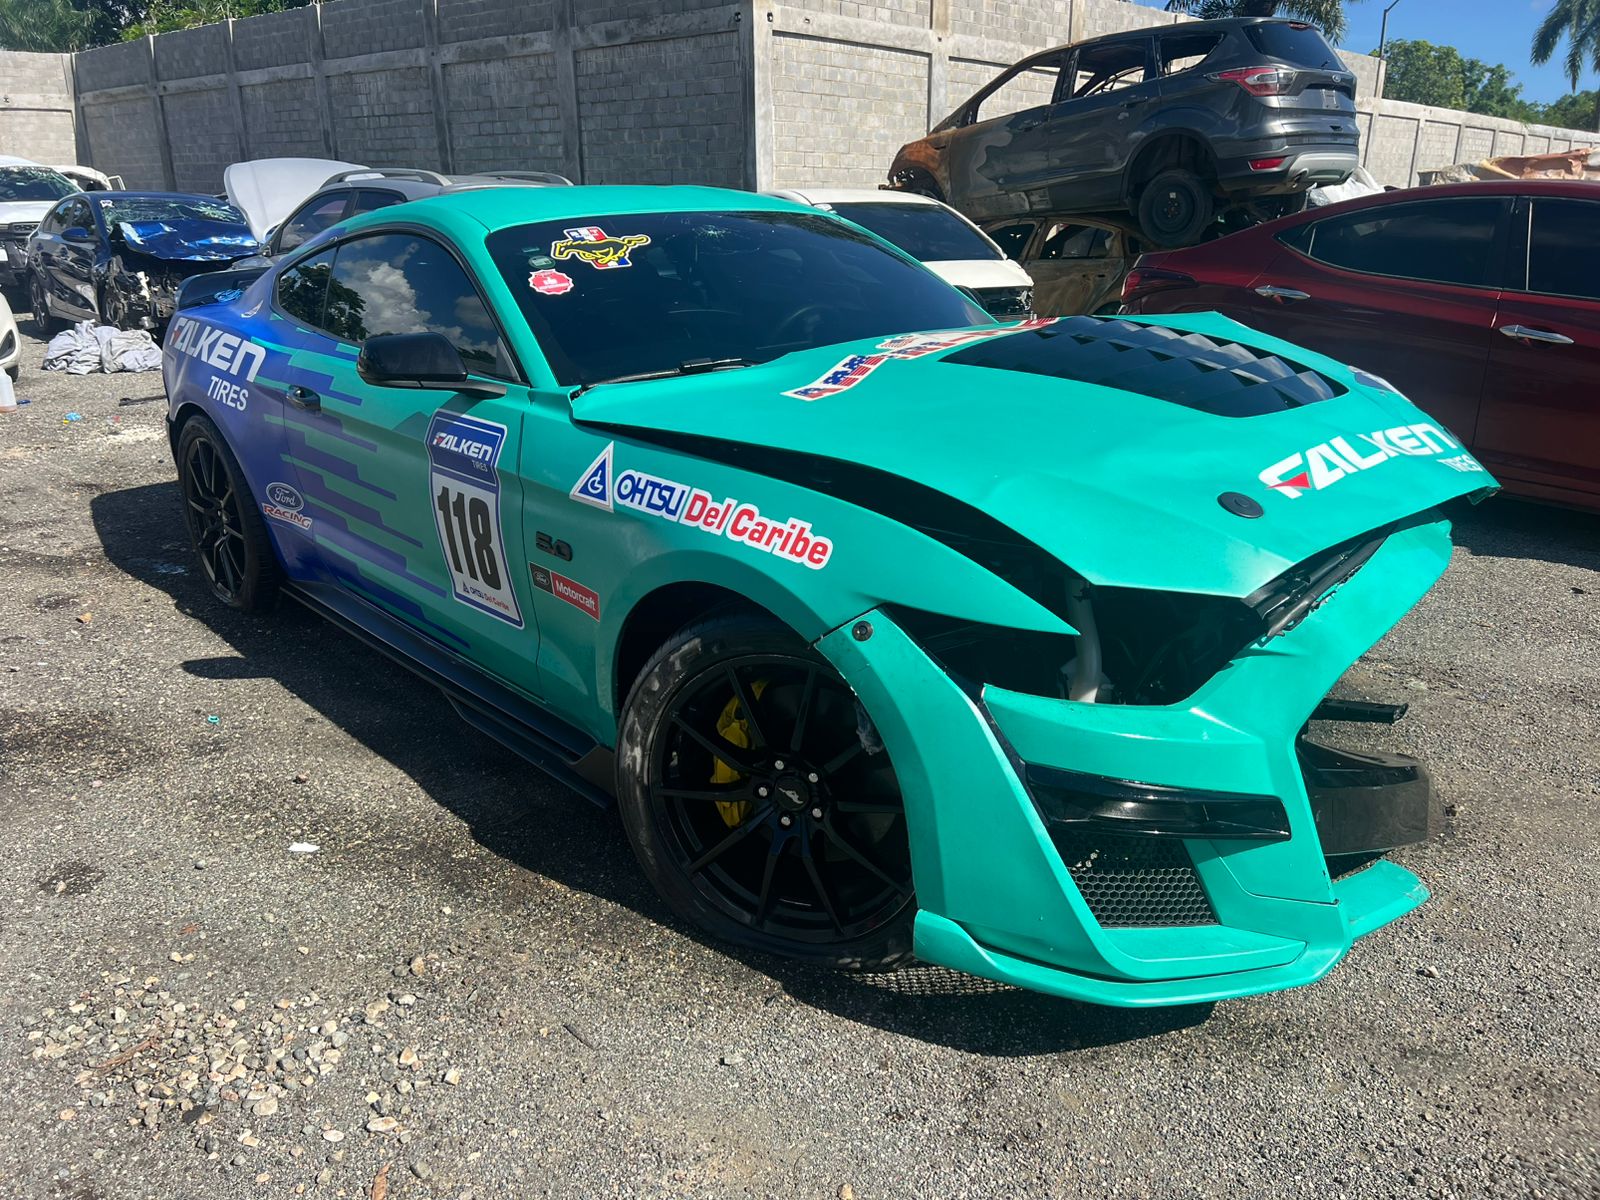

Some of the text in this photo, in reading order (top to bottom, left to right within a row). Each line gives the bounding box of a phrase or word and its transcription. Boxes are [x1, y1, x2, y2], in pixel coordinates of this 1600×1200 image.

[169, 317, 266, 383] FALKEN
[208, 375, 249, 411] TIRES
[433, 431, 493, 462] FALKEN
[1258, 423, 1458, 500] FALKEN
[274, 487, 296, 506] Ford
[264, 505, 311, 528] RACING
[616, 473, 829, 565] OHTSU Del Caribe
[437, 485, 502, 591] 118
[555, 580, 596, 611] Motorcraft
